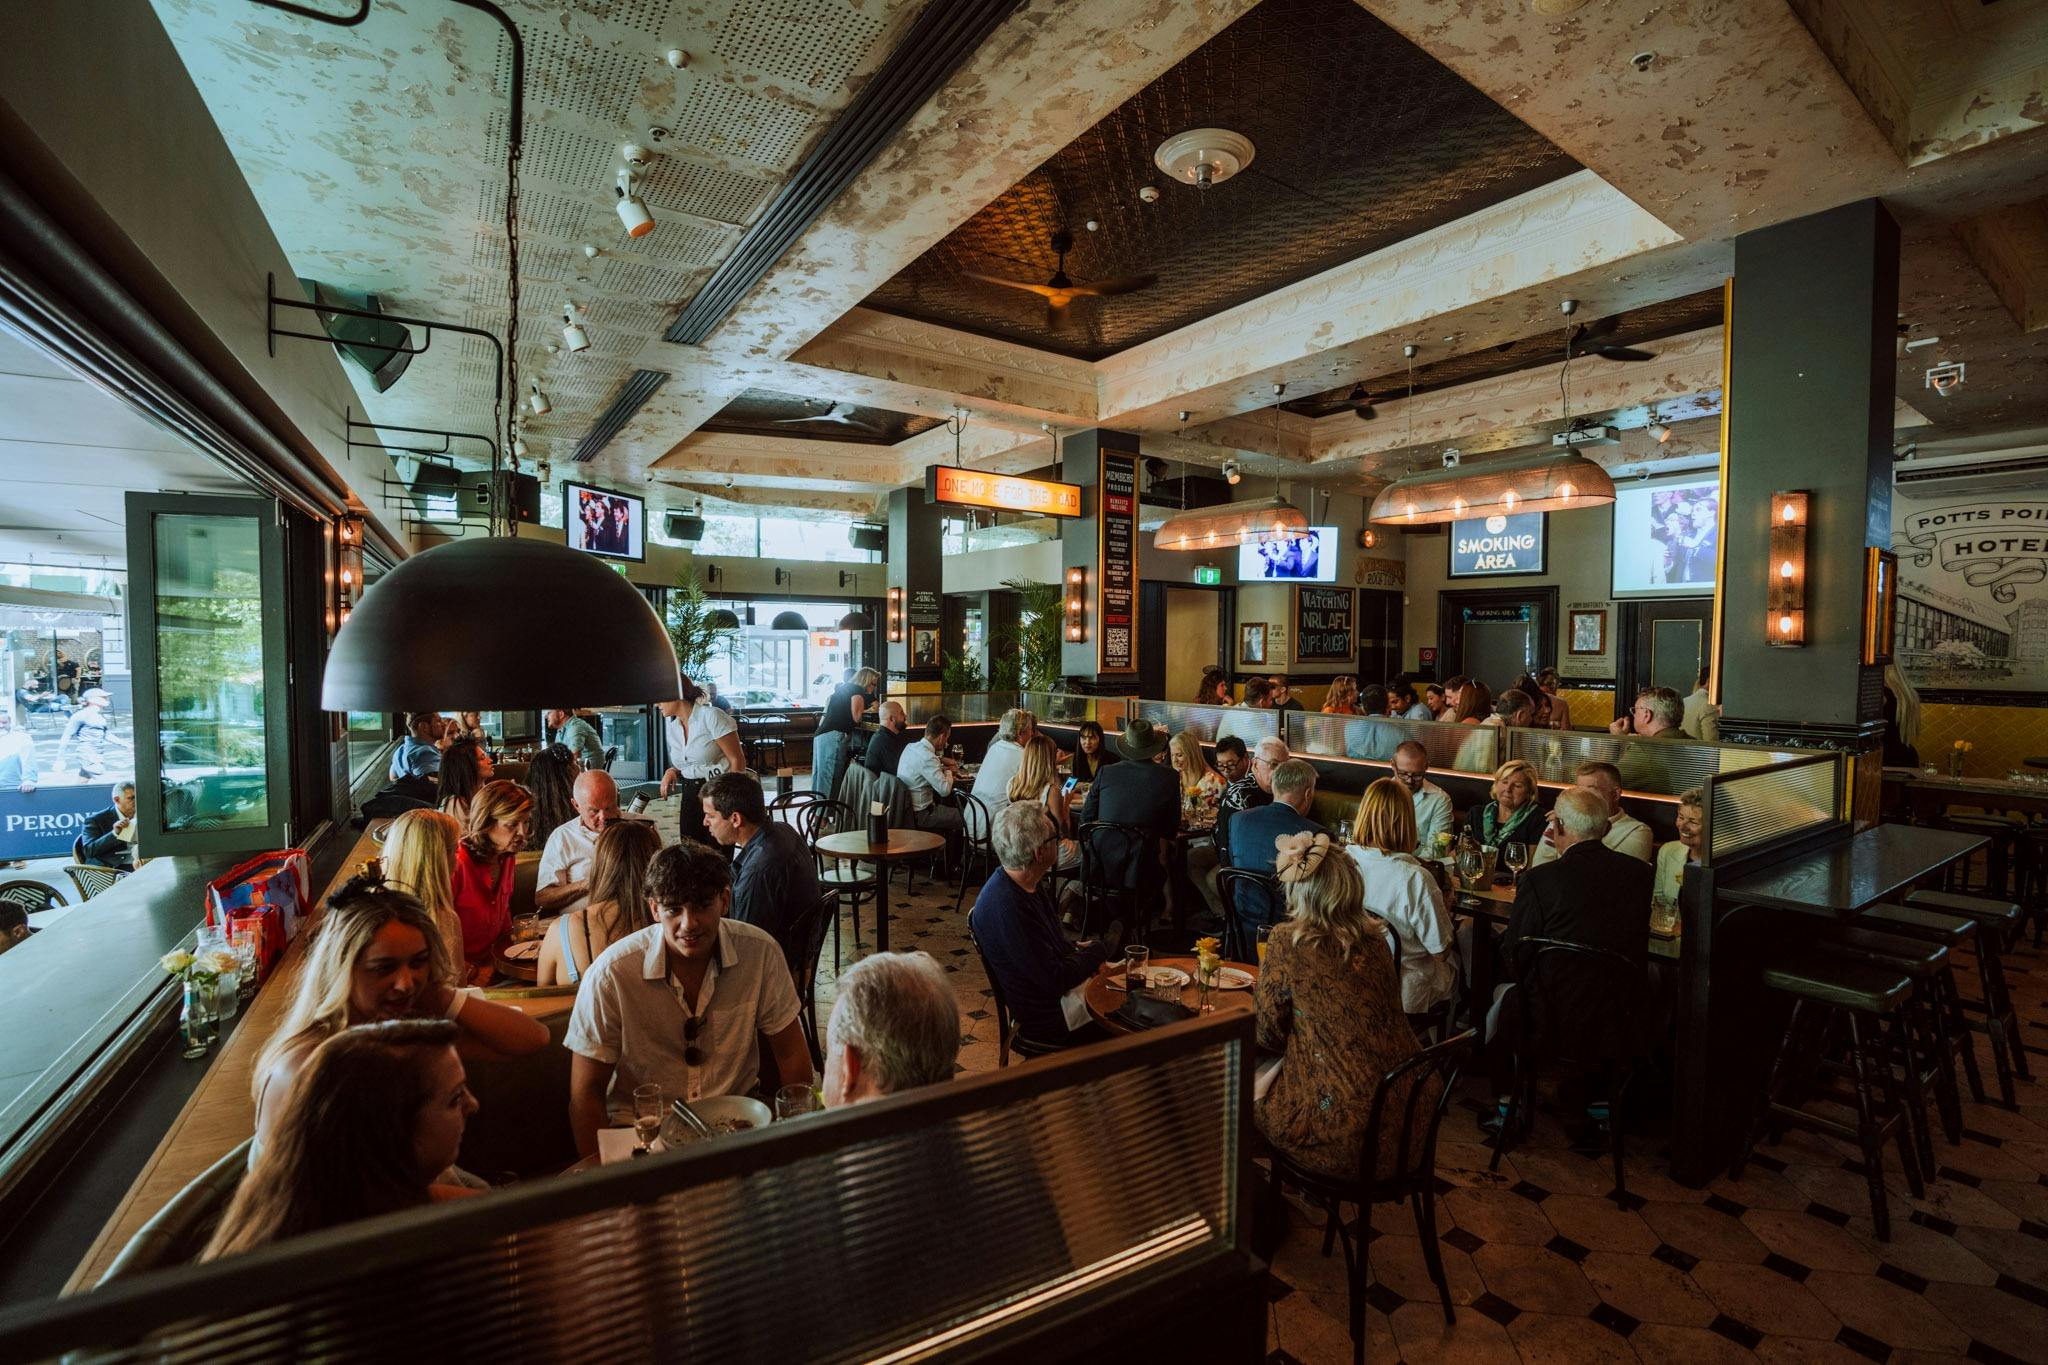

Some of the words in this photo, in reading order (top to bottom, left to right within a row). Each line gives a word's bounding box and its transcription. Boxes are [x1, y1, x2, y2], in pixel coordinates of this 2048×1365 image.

[1105, 470, 1134, 483] MEMBERS
[1106, 483, 1132, 493] PROGRAM
[1918, 510, 1990, 529] POTTS
[2001, 508, 2048, 519] POI
[1457, 534, 1536, 554] SMOKING
[1474, 552, 1517, 570] AREA
[1302, 591, 1349, 610] WATCHING
[1303, 612, 1327, 629] NRL
[1328, 612, 1351, 630] AFL
[1322, 632, 1351, 653] RUGBY
[7, 812, 98, 832] PERON
